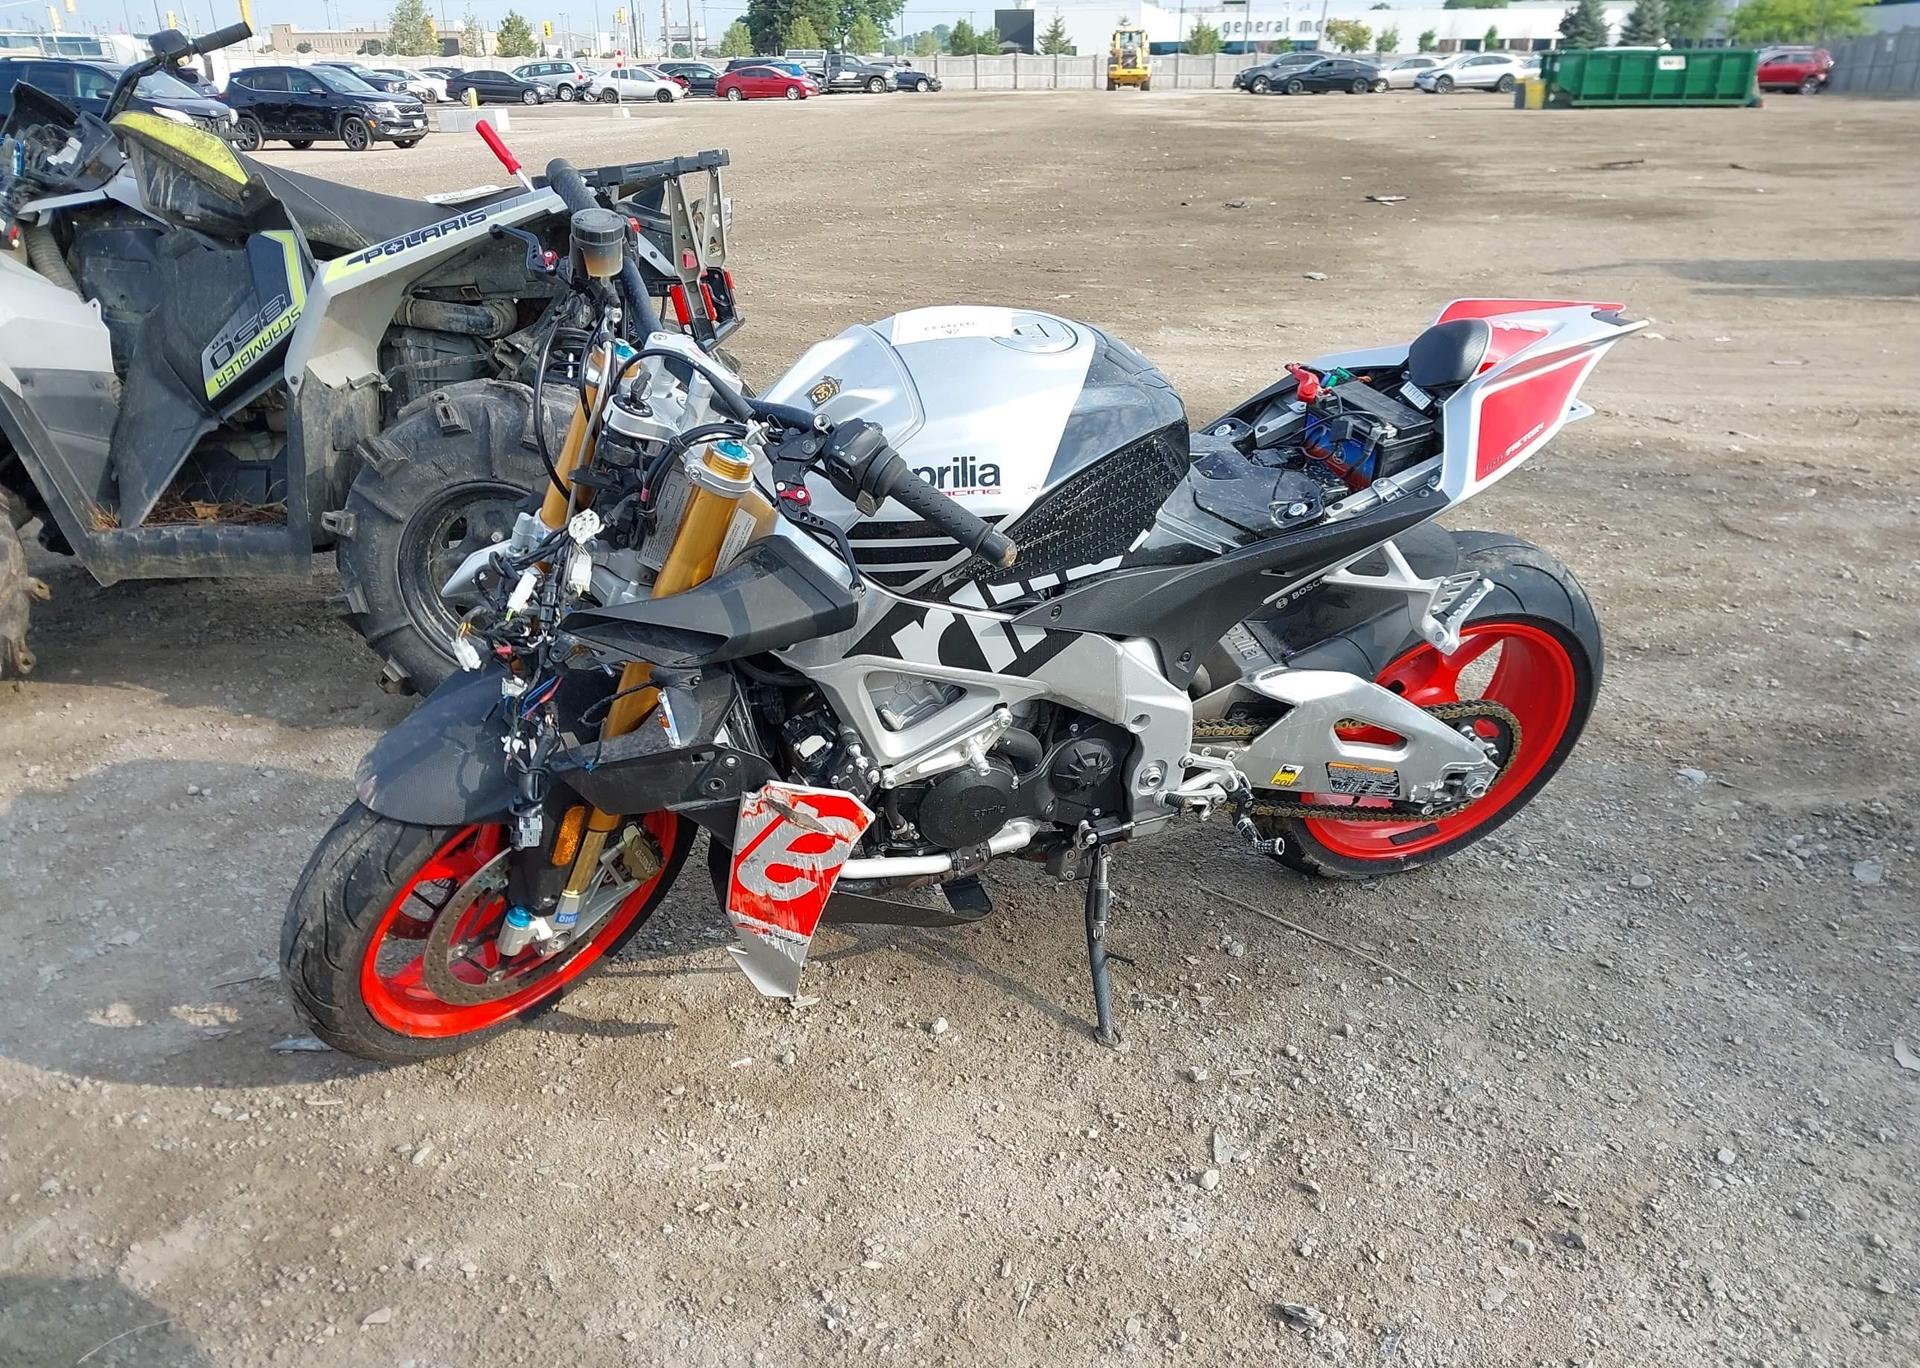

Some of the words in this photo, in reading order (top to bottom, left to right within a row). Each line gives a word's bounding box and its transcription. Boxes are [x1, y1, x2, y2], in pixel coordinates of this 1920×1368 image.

[1223, 18, 1290, 37] general
[362, 209, 488, 264] POLARIS
[209, 294, 287, 371] 850
[215, 305, 302, 388] SCRAMBLER
[912, 456, 1001, 489] prilia
